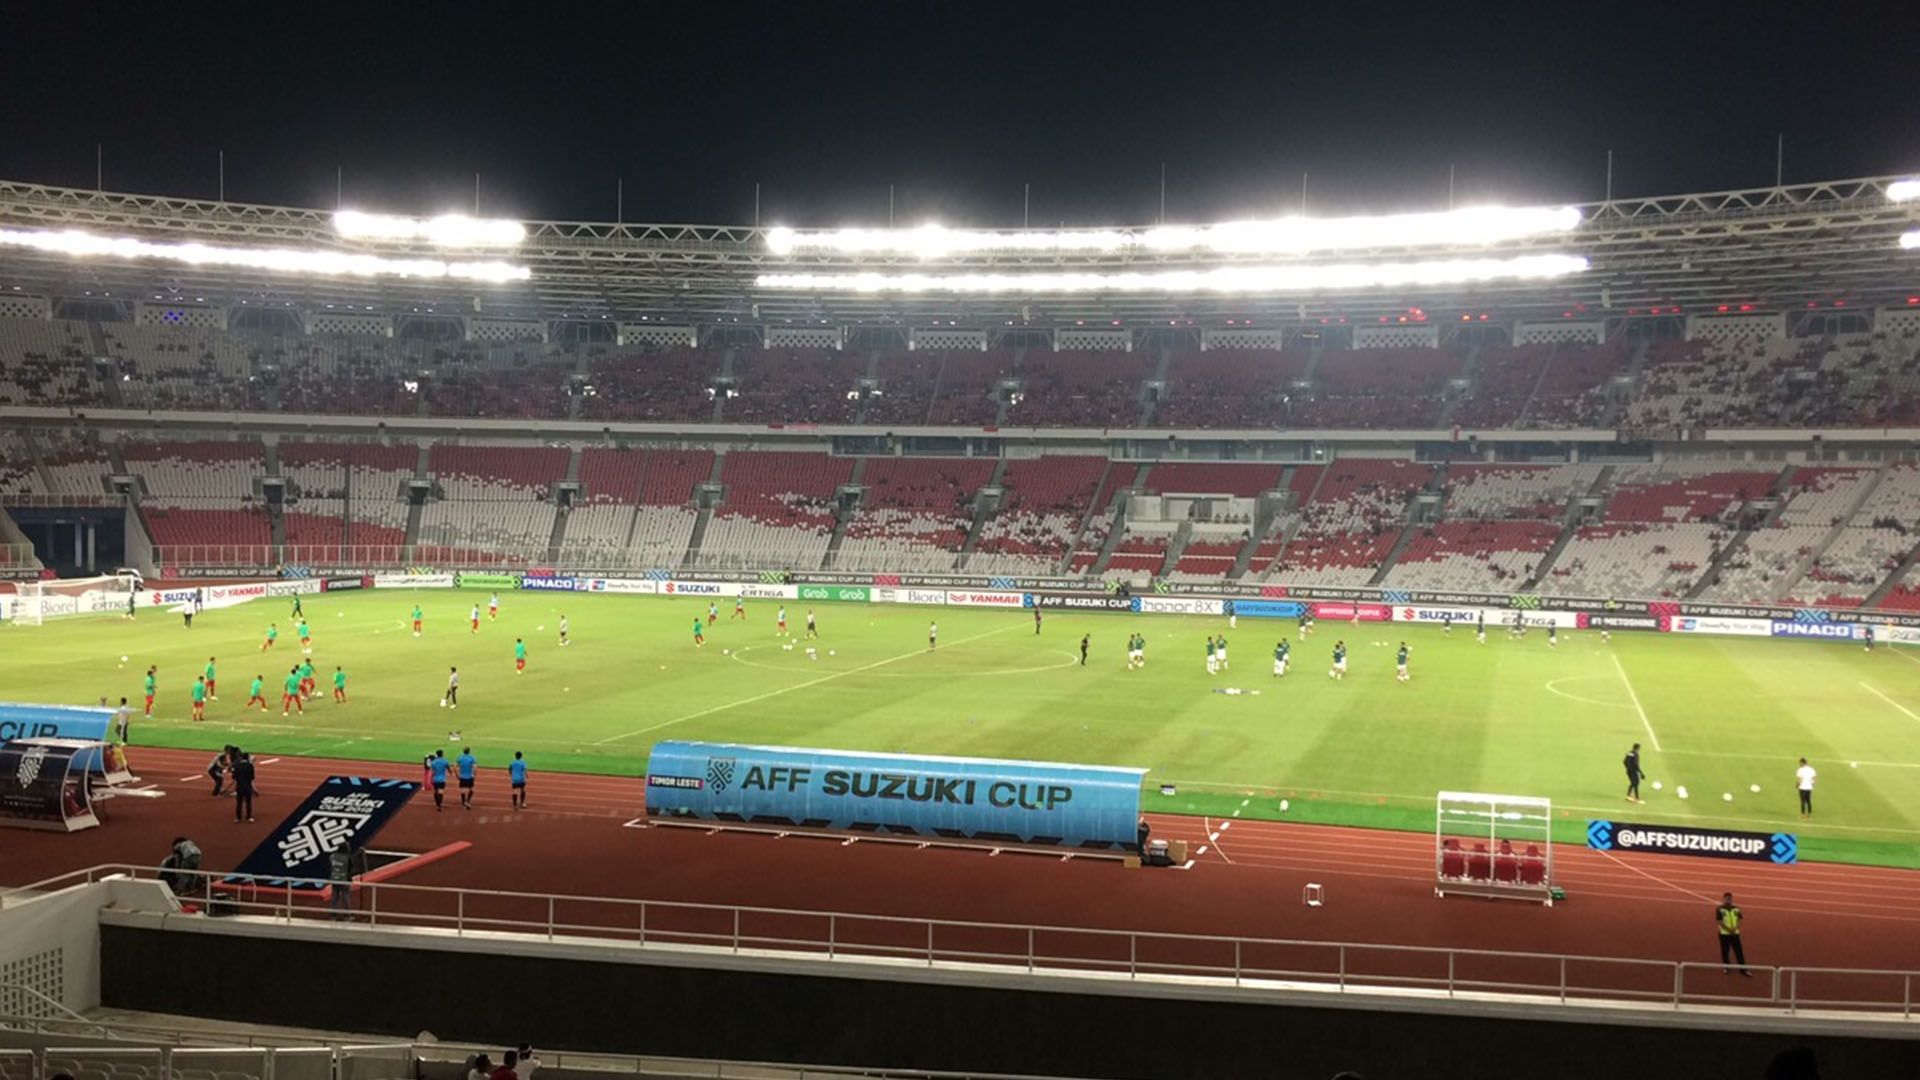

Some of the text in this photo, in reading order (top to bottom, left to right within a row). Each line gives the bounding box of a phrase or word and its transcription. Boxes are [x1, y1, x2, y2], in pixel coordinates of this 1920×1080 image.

[523, 578, 572, 588] PINACO
[678, 584, 720, 593] SUZUKI
[164, 591, 200, 602] SUZUK
[228, 587, 265, 596] YANMAR
[803, 587, 828, 598] Grab
[839, 589, 865, 600] Grab
[970, 594, 1020, 604] YANMAR
[1043, 598, 1131, 608] AFF SUZUKI CUP
[1144, 600, 1192, 612] honor
[1710, 607, 1746, 616] SUZUKI
[1419, 610, 1473, 620] SUZUKI
[1774, 623, 1849, 636] PINACO
[0, 720, 58, 742] CUP
[651, 776, 700, 788] TIMOR LESTE
[741, 766, 1072, 810] AFF SUZUKI CUP
[321, 796, 385, 808] SUZUKI
[1617, 829, 1766, 854] @AFFSUZUKICUP
